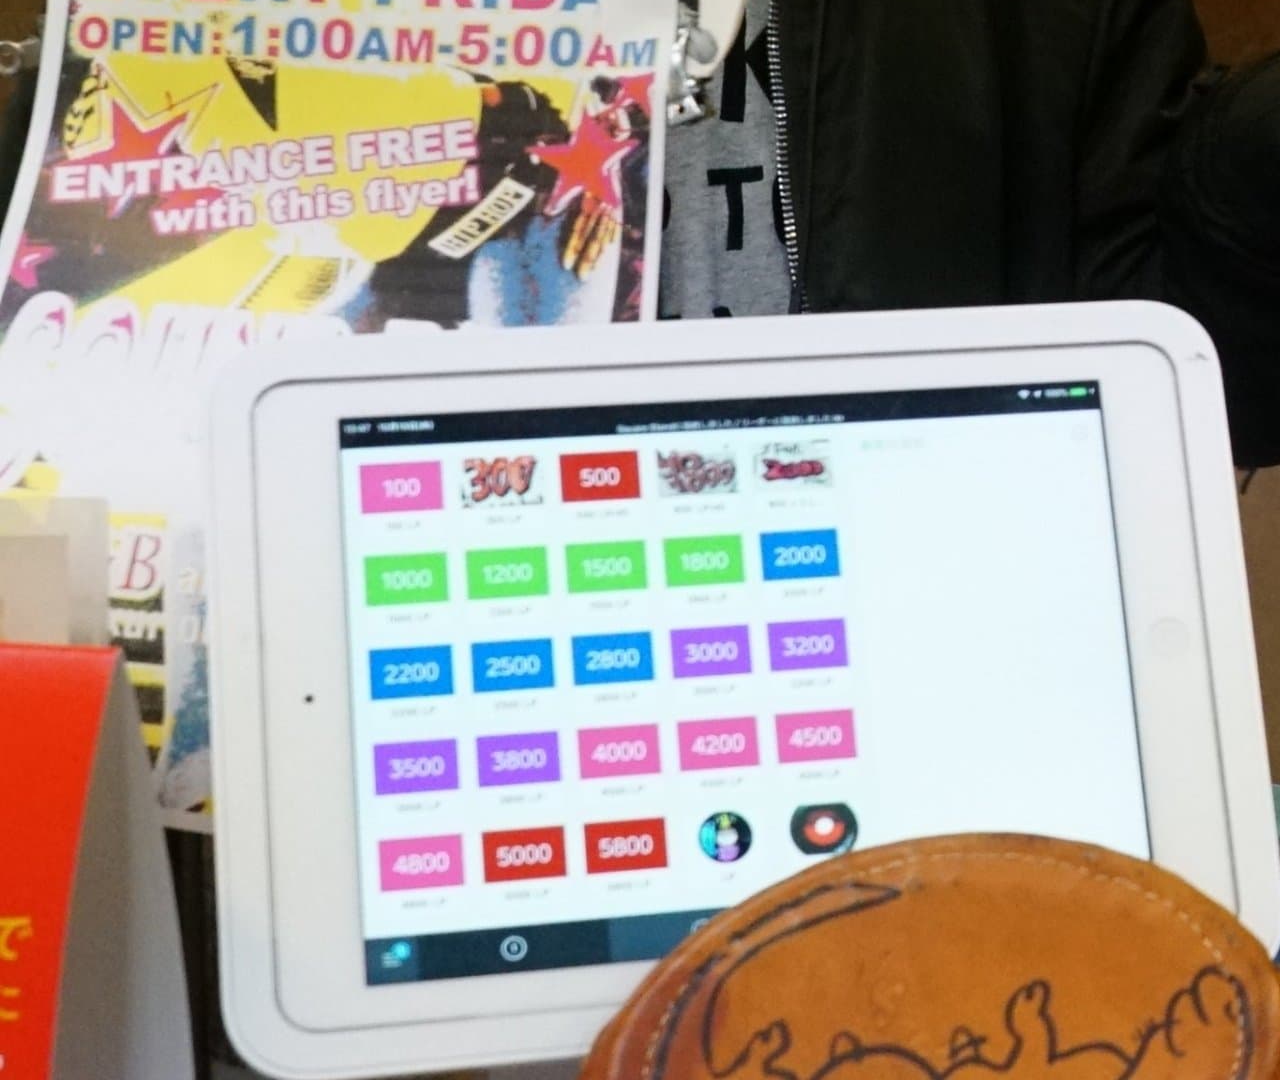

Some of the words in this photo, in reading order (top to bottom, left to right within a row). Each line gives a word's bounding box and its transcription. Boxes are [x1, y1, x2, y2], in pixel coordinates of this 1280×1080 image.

[50, 136, 336, 201] ENTRANCE
[349, 121, 479, 172] FREE
[152, 197, 255, 235] with
[267, 185, 352, 227] this
[366, 166, 481, 220] flyer!
[381, 477, 422, 498] 100
[580, 466, 621, 487] 500
[580, 556, 632, 578] 1500
[680, 550, 730, 572] 1800
[774, 544, 826, 567] 2000
[381, 569, 433, 591] 1000
[482, 563, 533, 584] 1200
[684, 641, 738, 664] 3000
[781, 634, 835, 657] 3200
[485, 654, 541, 678] 2500
[585, 647, 641, 672] 2800
[384, 661, 440, 686] 2200
[691, 732, 746, 756] 4200
[788, 725, 843, 748] 4500
[490, 748, 547, 772] 3800
[591, 740, 648, 764] 4000
[388, 755, 445, 780] 3500
[496, 843, 554, 868] 5000
[598, 834, 654, 859] 5800
[391, 852, 450, 876] 4800
